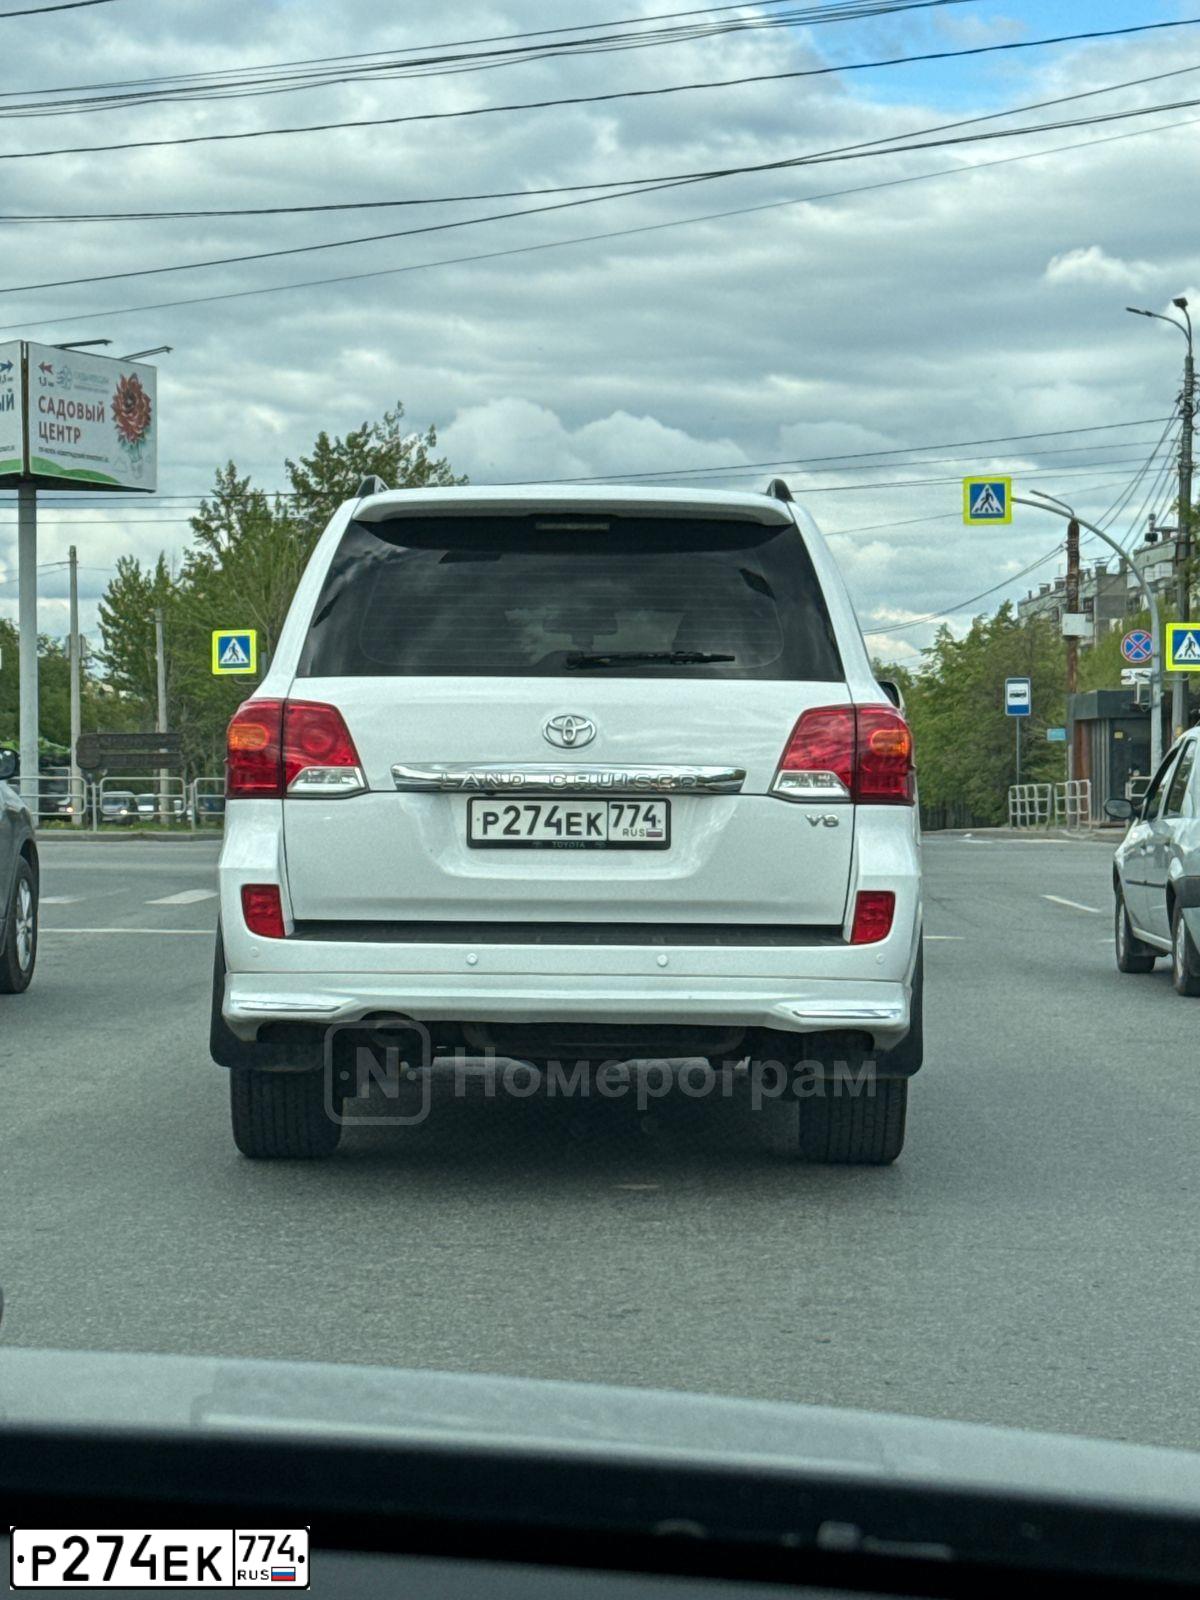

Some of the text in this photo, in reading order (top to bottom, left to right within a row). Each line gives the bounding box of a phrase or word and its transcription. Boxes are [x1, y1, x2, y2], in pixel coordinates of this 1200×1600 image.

[38, 396, 105, 423] САДОВЫЙ
[38, 421, 81, 444] ЦЕНТР
[440, 773, 698, 790] LAND CRUISER
[610, 804, 657, 828] 774
[804, 814, 840, 828] V8
[622, 828, 645, 837] RUS
[551, 841, 585, 849] TOYOTA
